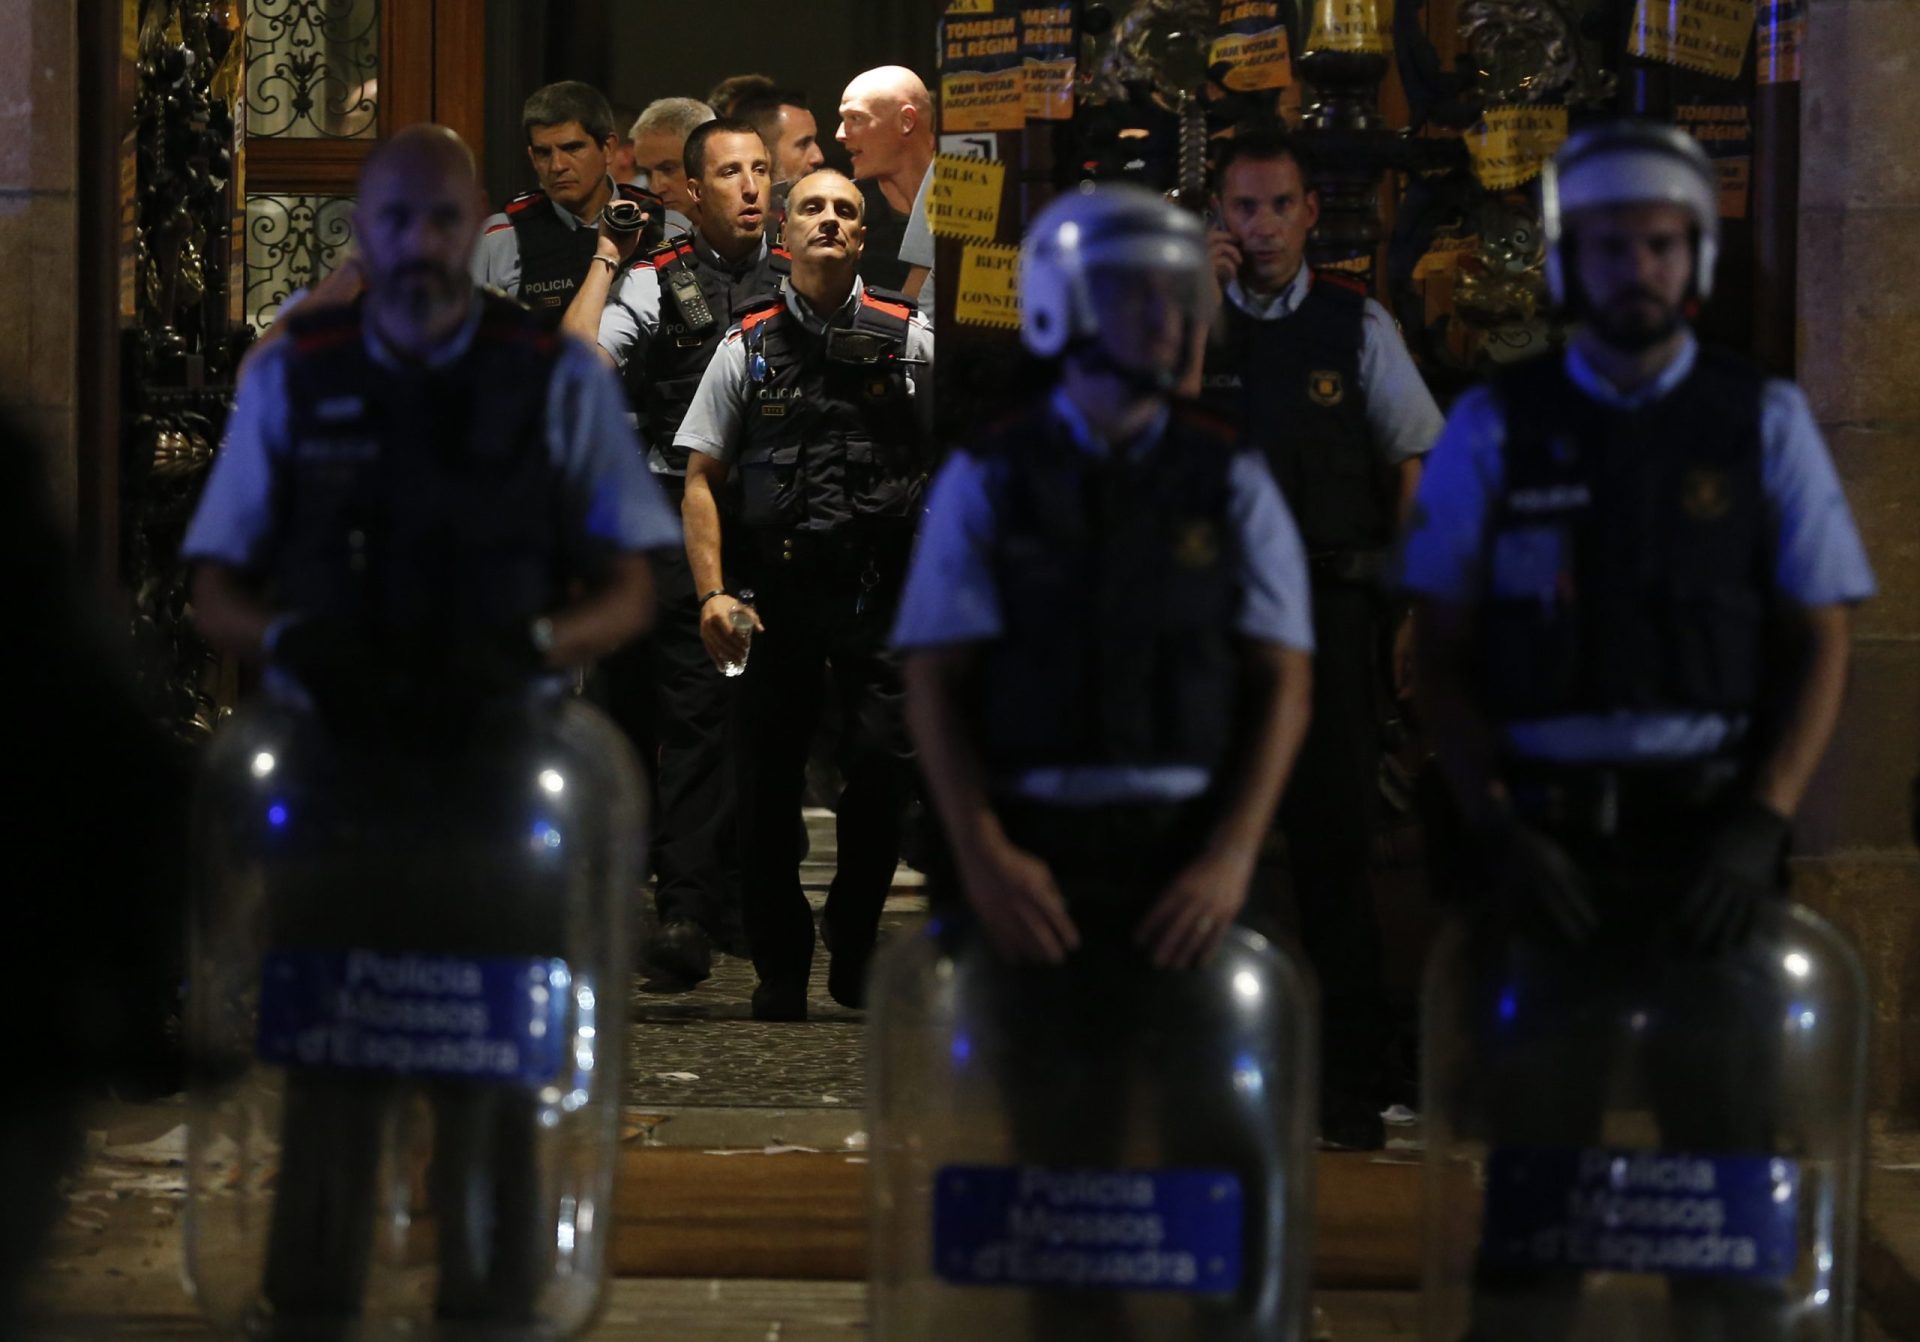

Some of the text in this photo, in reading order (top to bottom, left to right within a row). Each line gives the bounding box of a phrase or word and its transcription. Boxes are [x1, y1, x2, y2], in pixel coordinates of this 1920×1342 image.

[1021, 8, 1072, 24] MBEM
[945, 18, 1016, 39] TOMBEM
[947, 42, 963, 59] EL
[1242, 39, 1278, 54] VOTAR
[949, 83, 976, 95] VAM
[978, 79, 1014, 92] VOTAR
[525, 278, 574, 295] POLICIA
